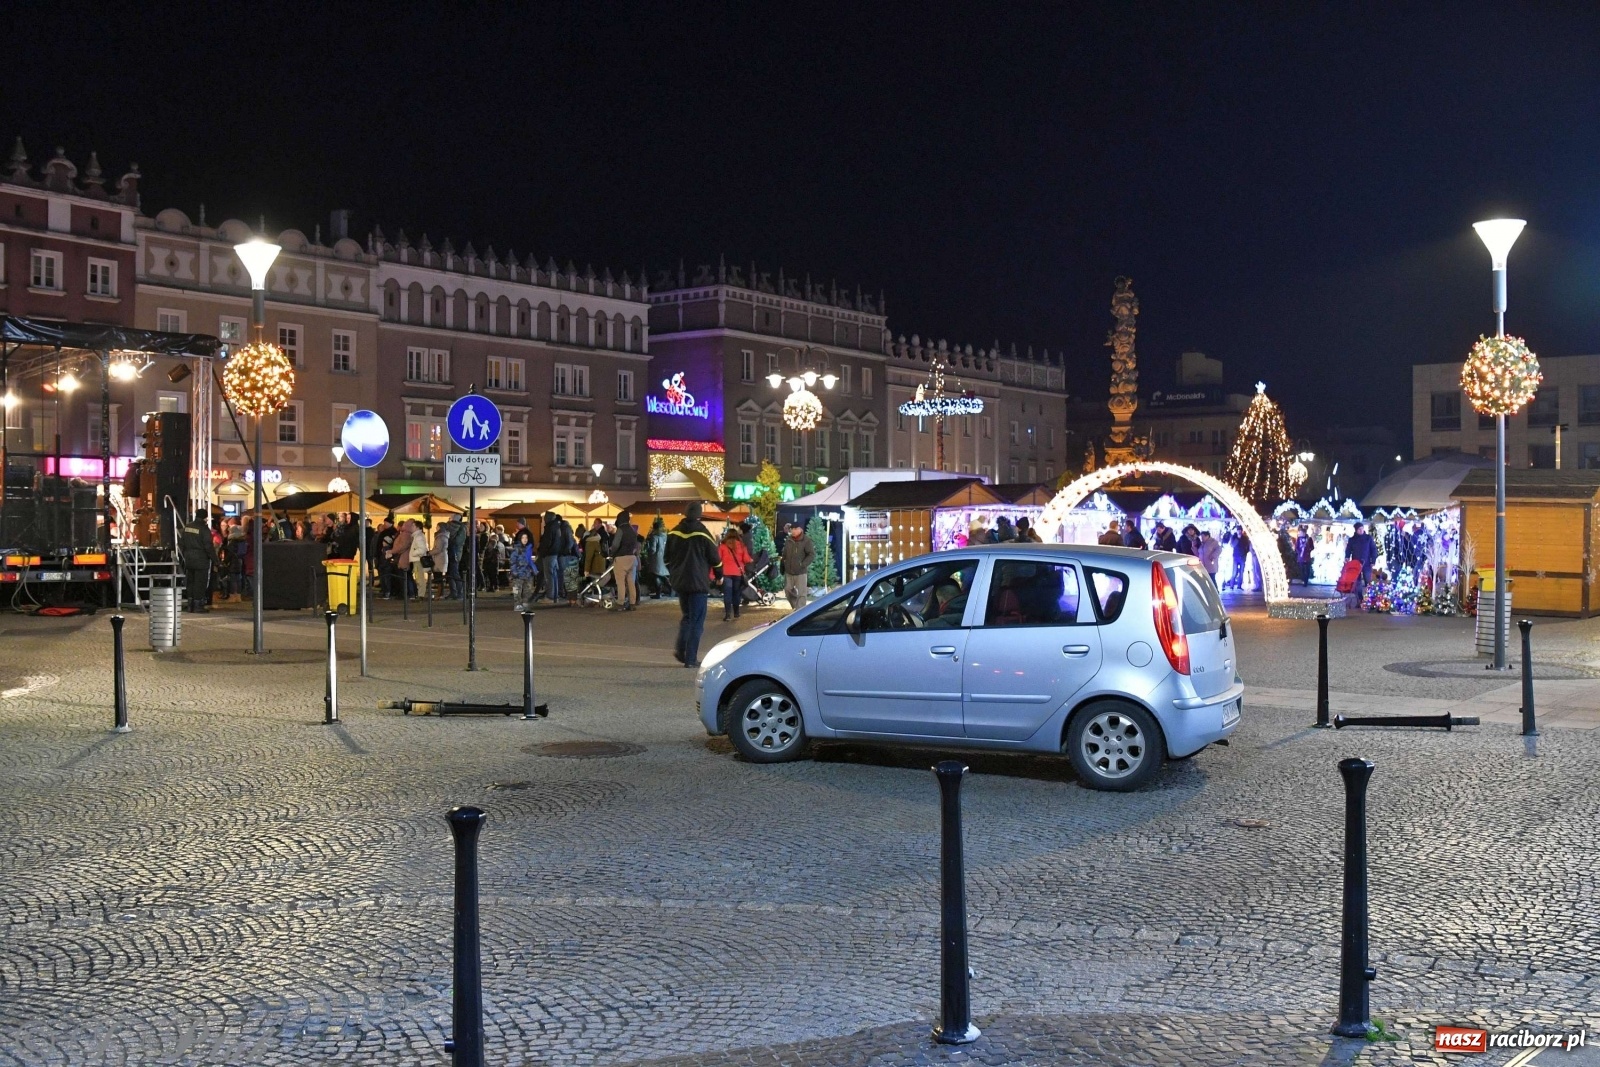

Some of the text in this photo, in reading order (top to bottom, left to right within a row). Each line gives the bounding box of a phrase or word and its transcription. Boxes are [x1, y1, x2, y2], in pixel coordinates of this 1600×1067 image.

[1166, 392, 1205, 401] McDonald's
[447, 455, 498, 465] Nie dotyczy
[245, 469, 282, 483] SIRO
[732, 484, 795, 502] APTA
